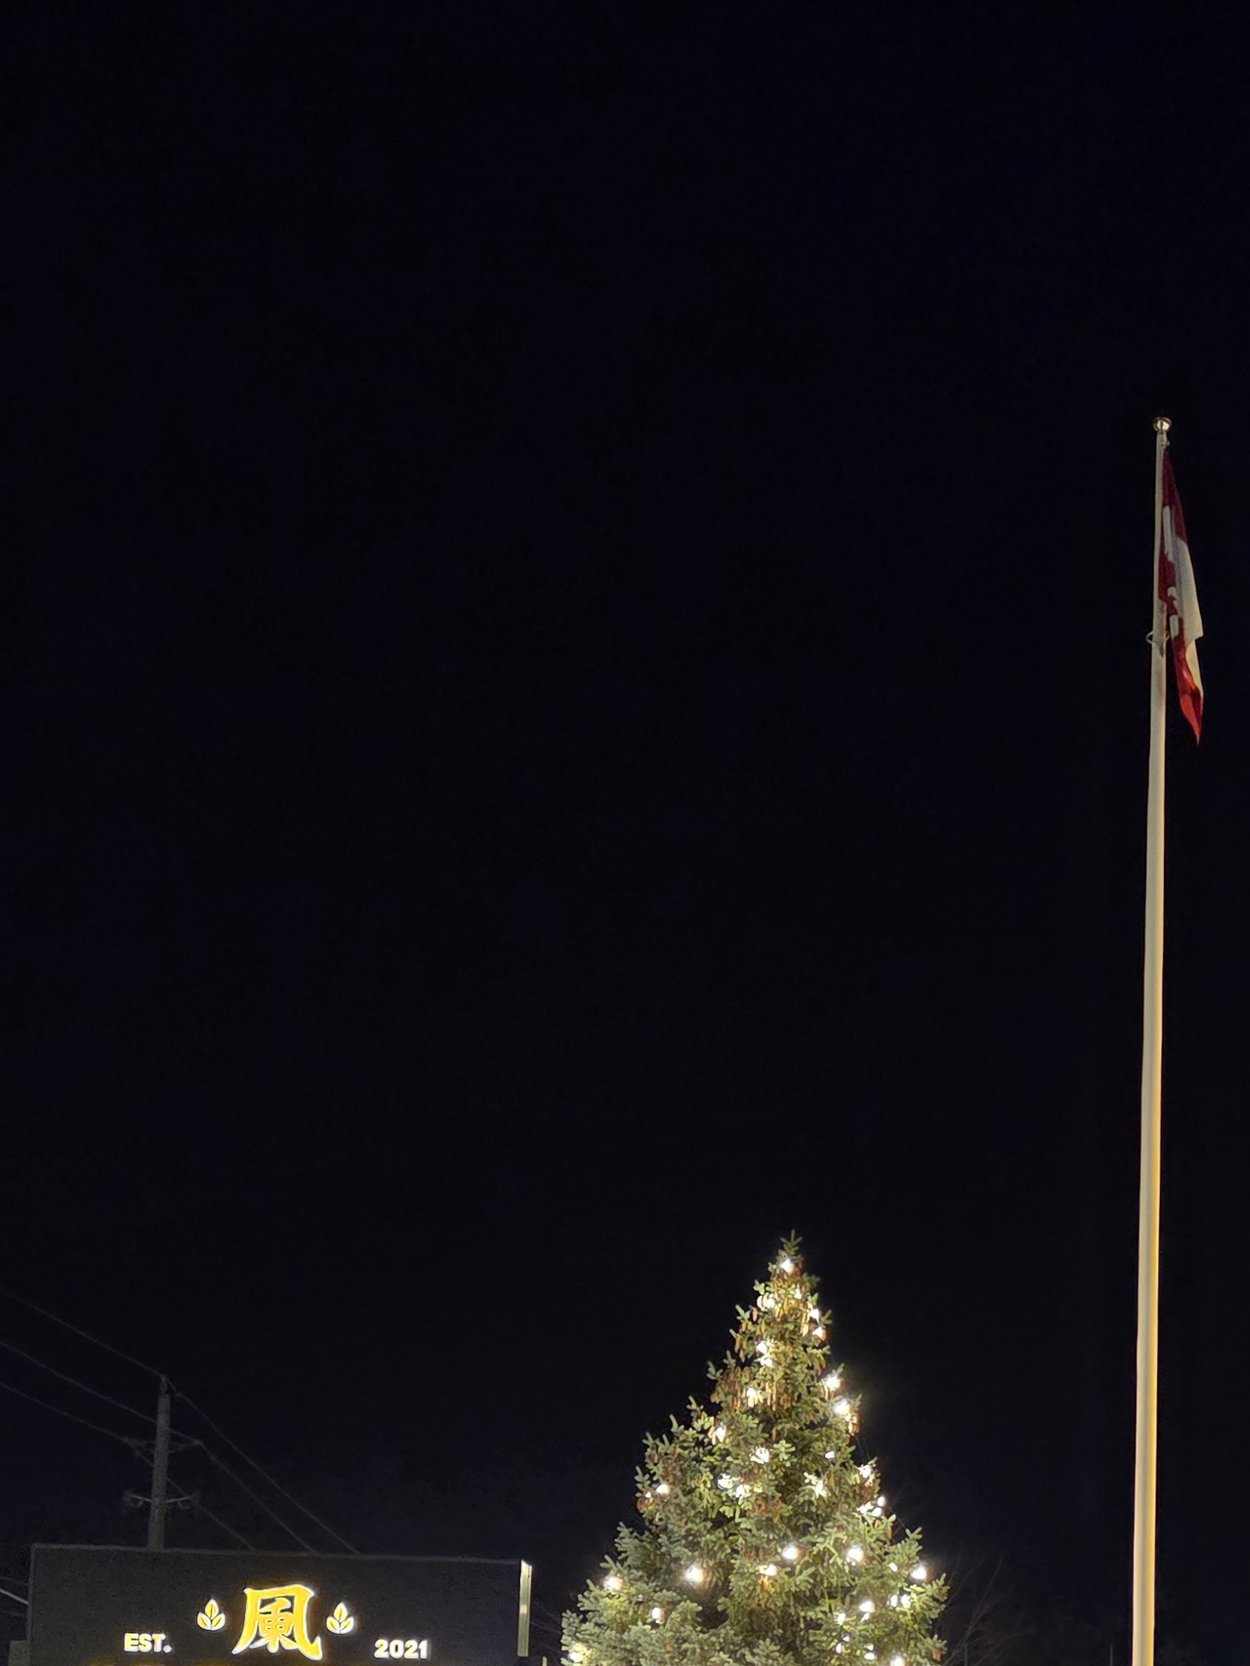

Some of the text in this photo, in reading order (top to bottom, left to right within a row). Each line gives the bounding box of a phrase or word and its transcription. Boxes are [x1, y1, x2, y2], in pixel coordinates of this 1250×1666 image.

[124, 1633, 428, 1659] EST. 2021
[232, 1584, 323, 1661] 風
